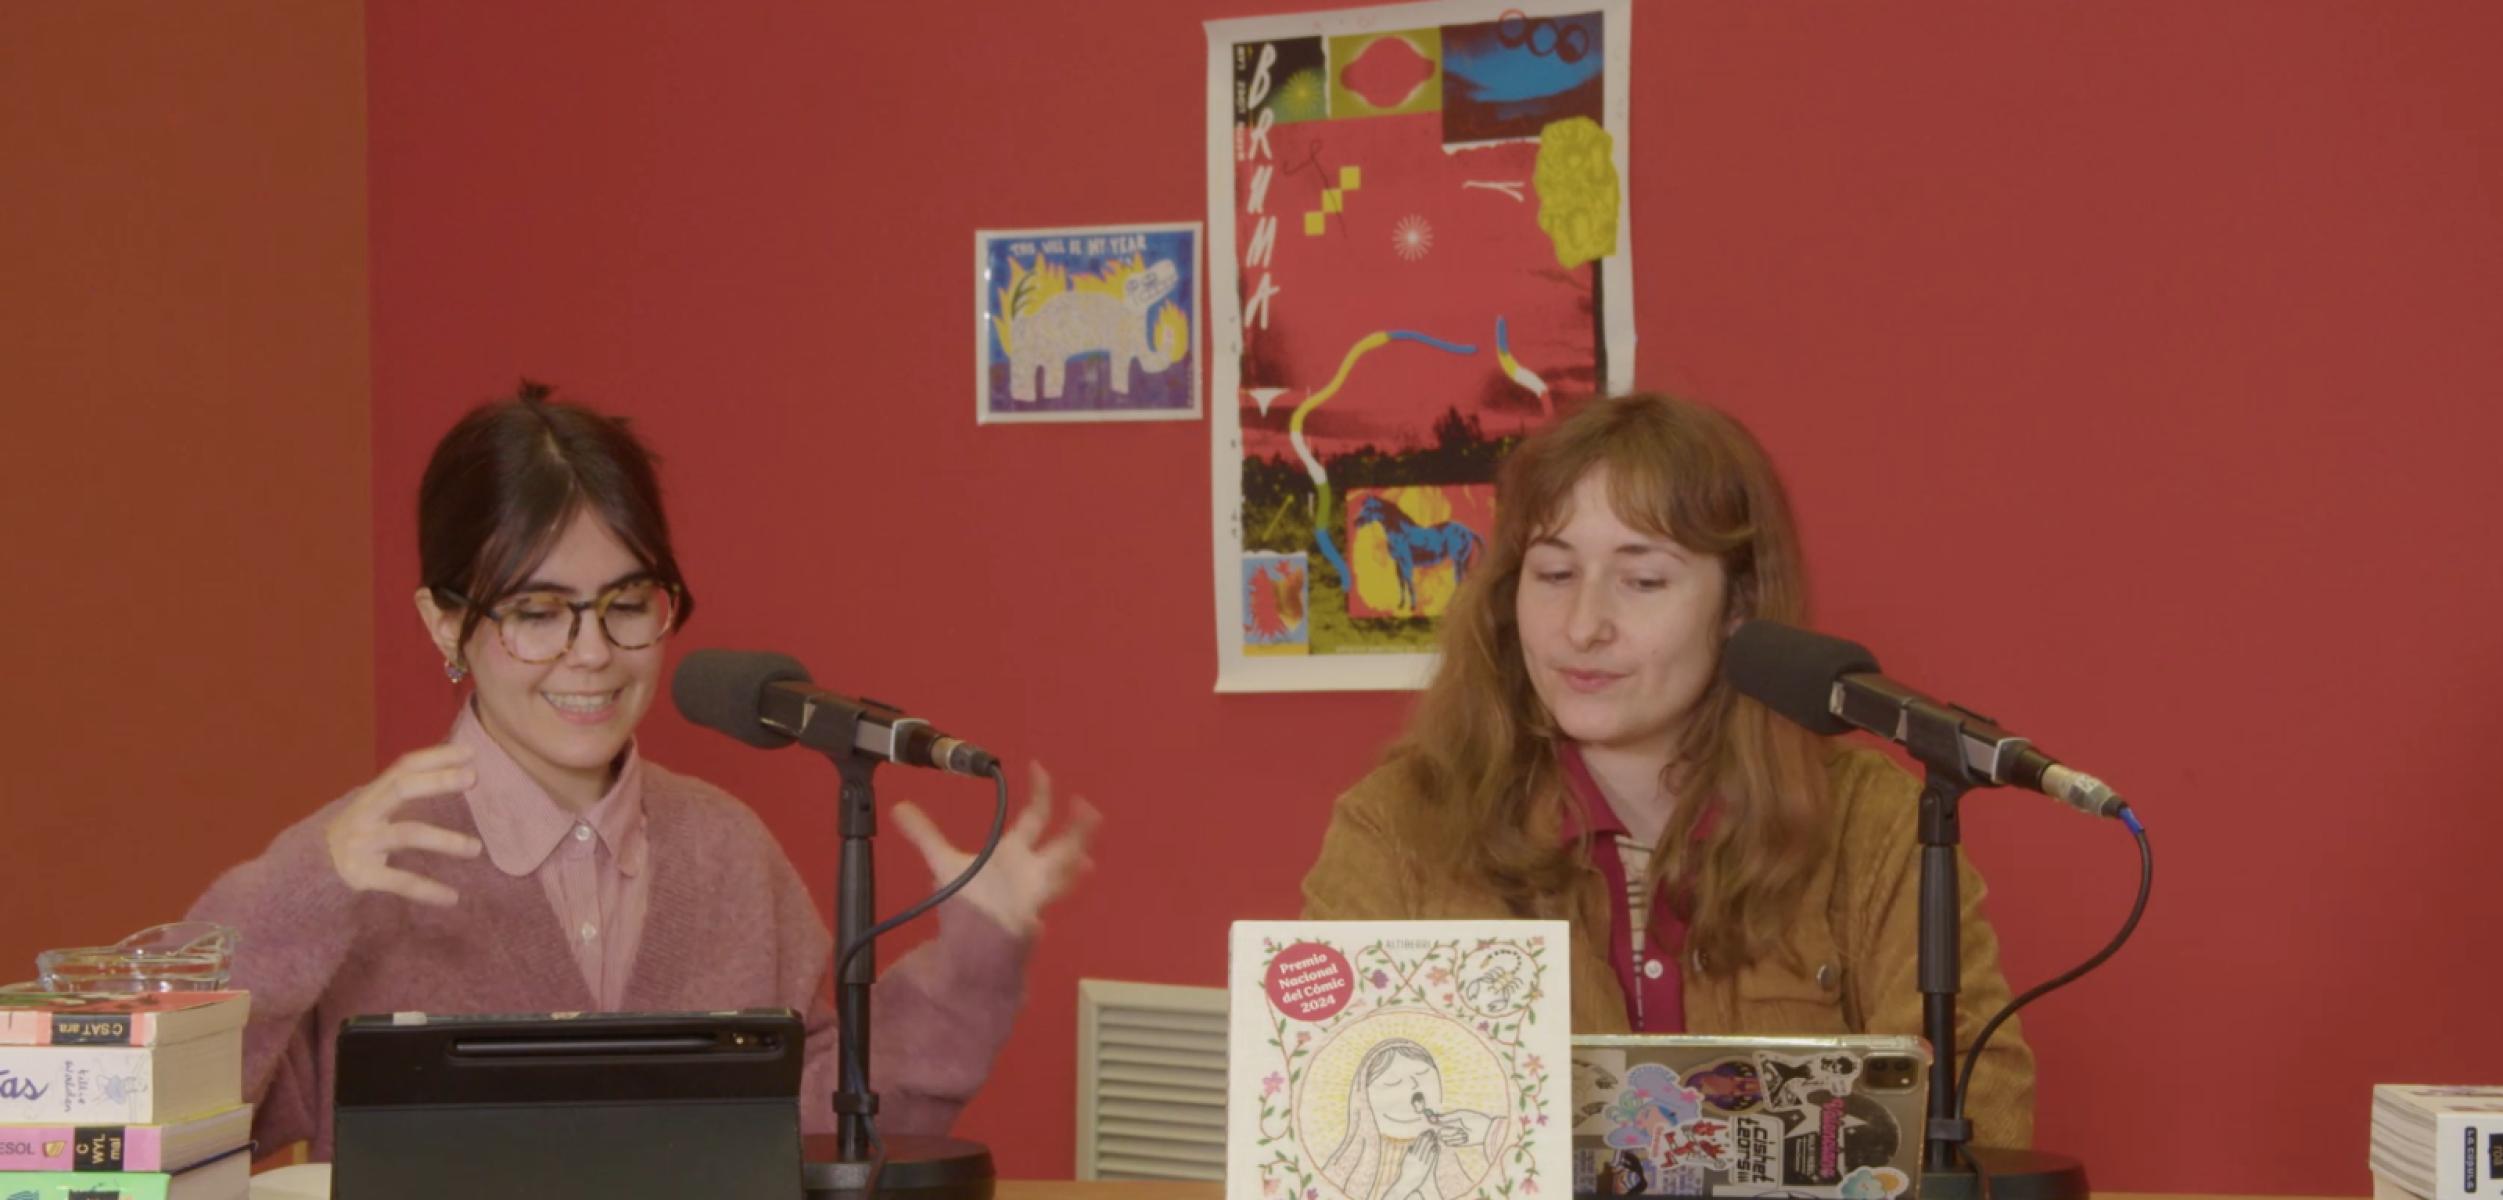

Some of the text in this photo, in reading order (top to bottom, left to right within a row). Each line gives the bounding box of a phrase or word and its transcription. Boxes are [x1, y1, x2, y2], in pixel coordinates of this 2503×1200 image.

[1245, 42, 1280, 330] BRUMA
[1110, 234, 1147, 254] YEAR
[1279, 953, 1328, 975] Premio
[1278, 963, 1339, 990] Nacional
[1282, 978, 1345, 1004] del Cómic
[1300, 994, 1337, 1014] 2024
[83, 1022, 110, 1037] SAT
[112, 1022, 124, 1037] C
